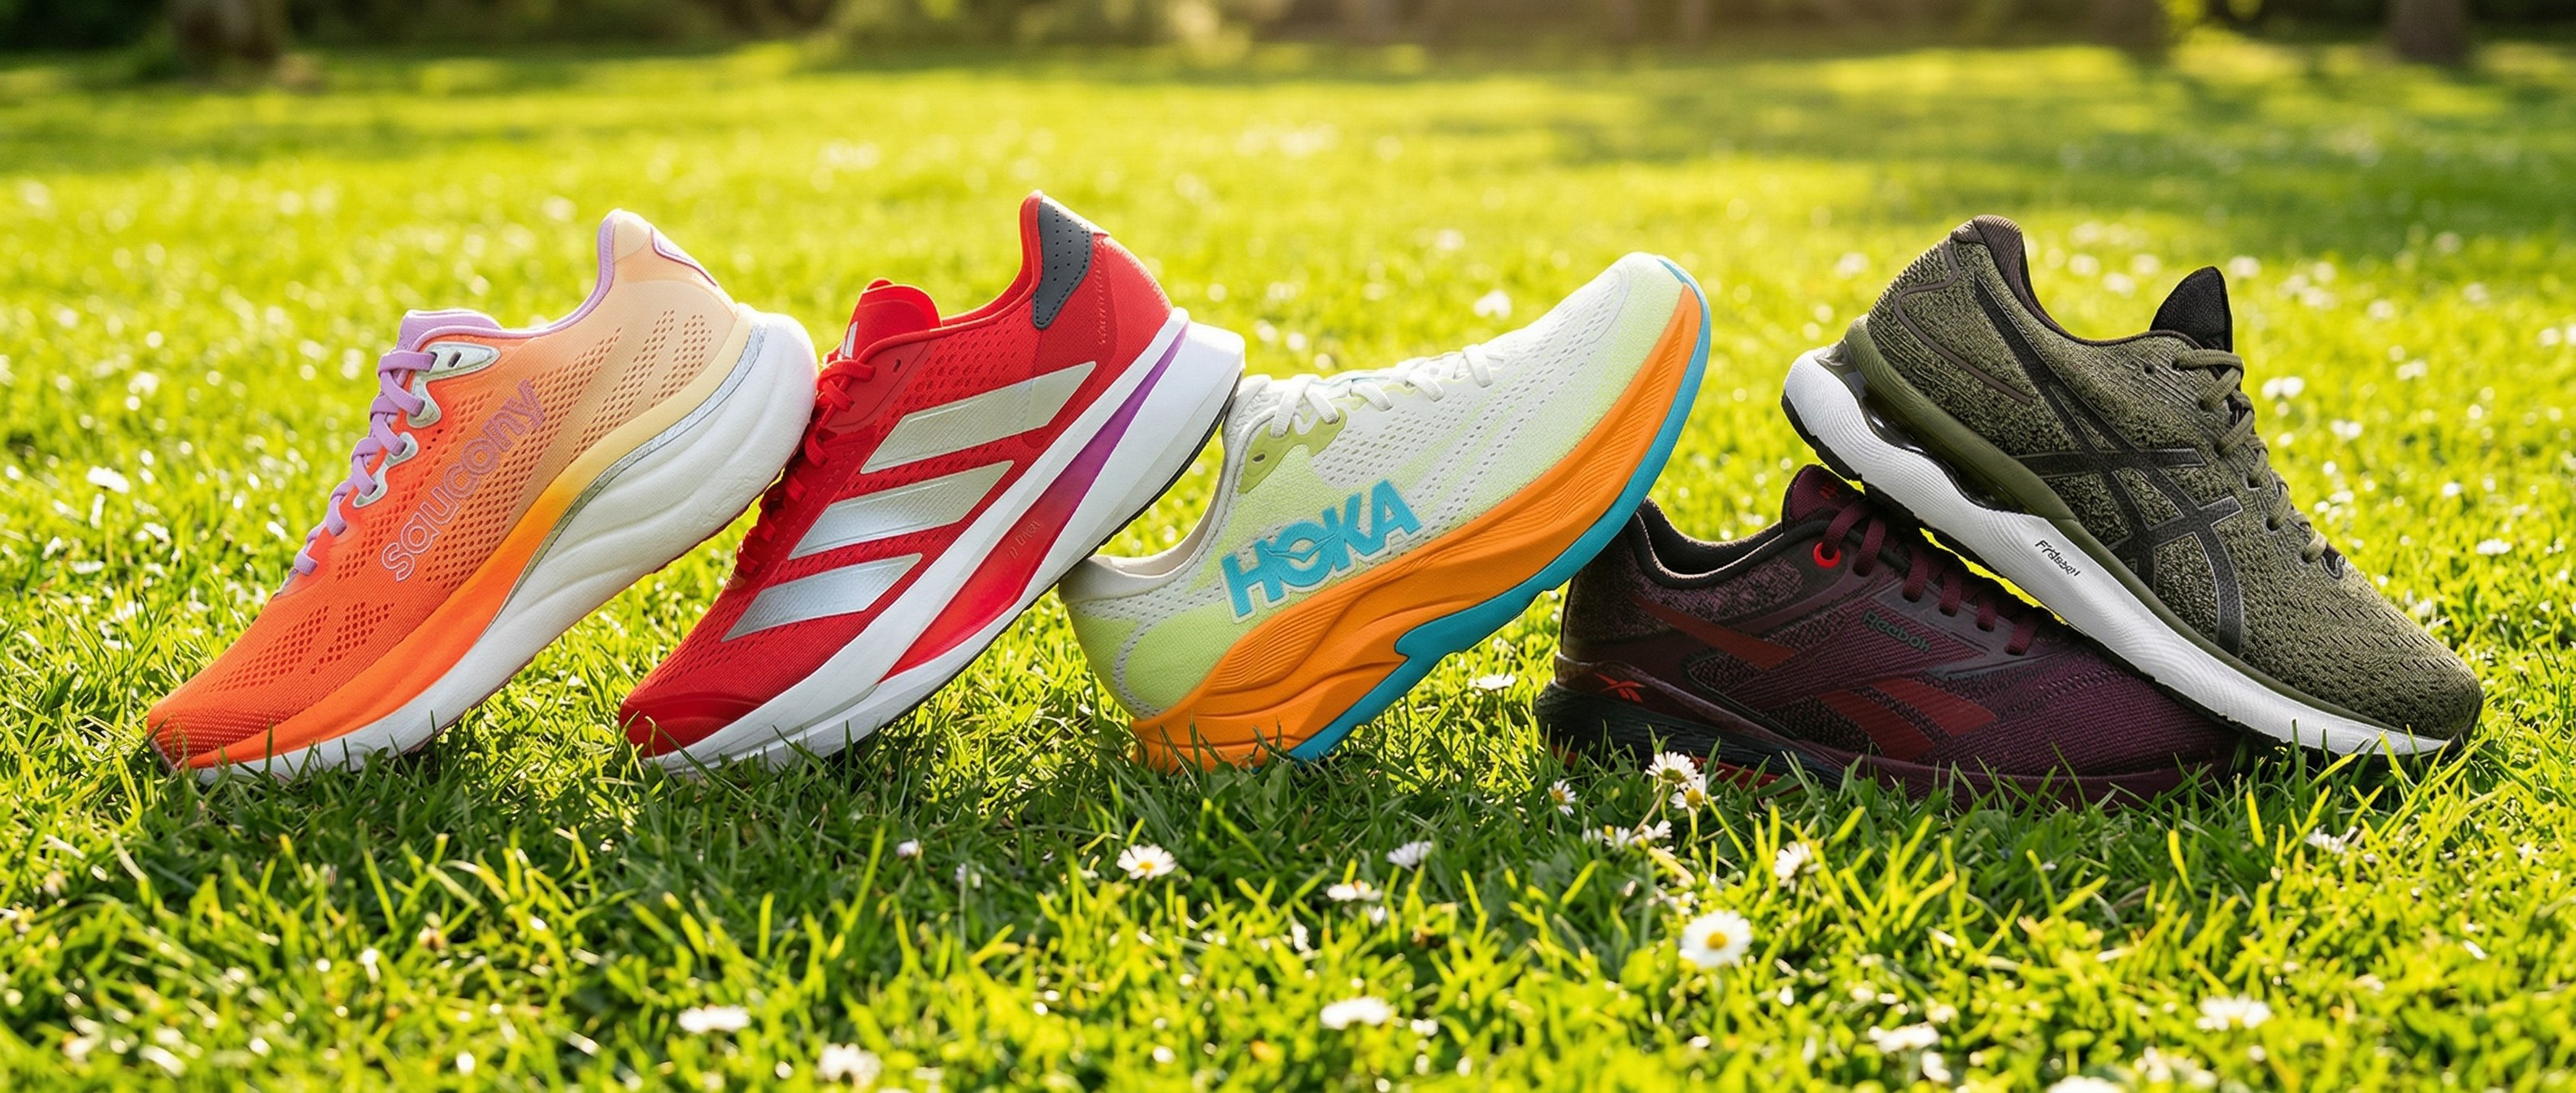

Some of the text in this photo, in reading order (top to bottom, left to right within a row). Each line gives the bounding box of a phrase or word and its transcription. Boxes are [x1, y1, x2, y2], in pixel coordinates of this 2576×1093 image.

[381, 377, 546, 581] saucony
[1222, 478, 1423, 618] HOKA
[1862, 610, 1930, 652] Reebok
